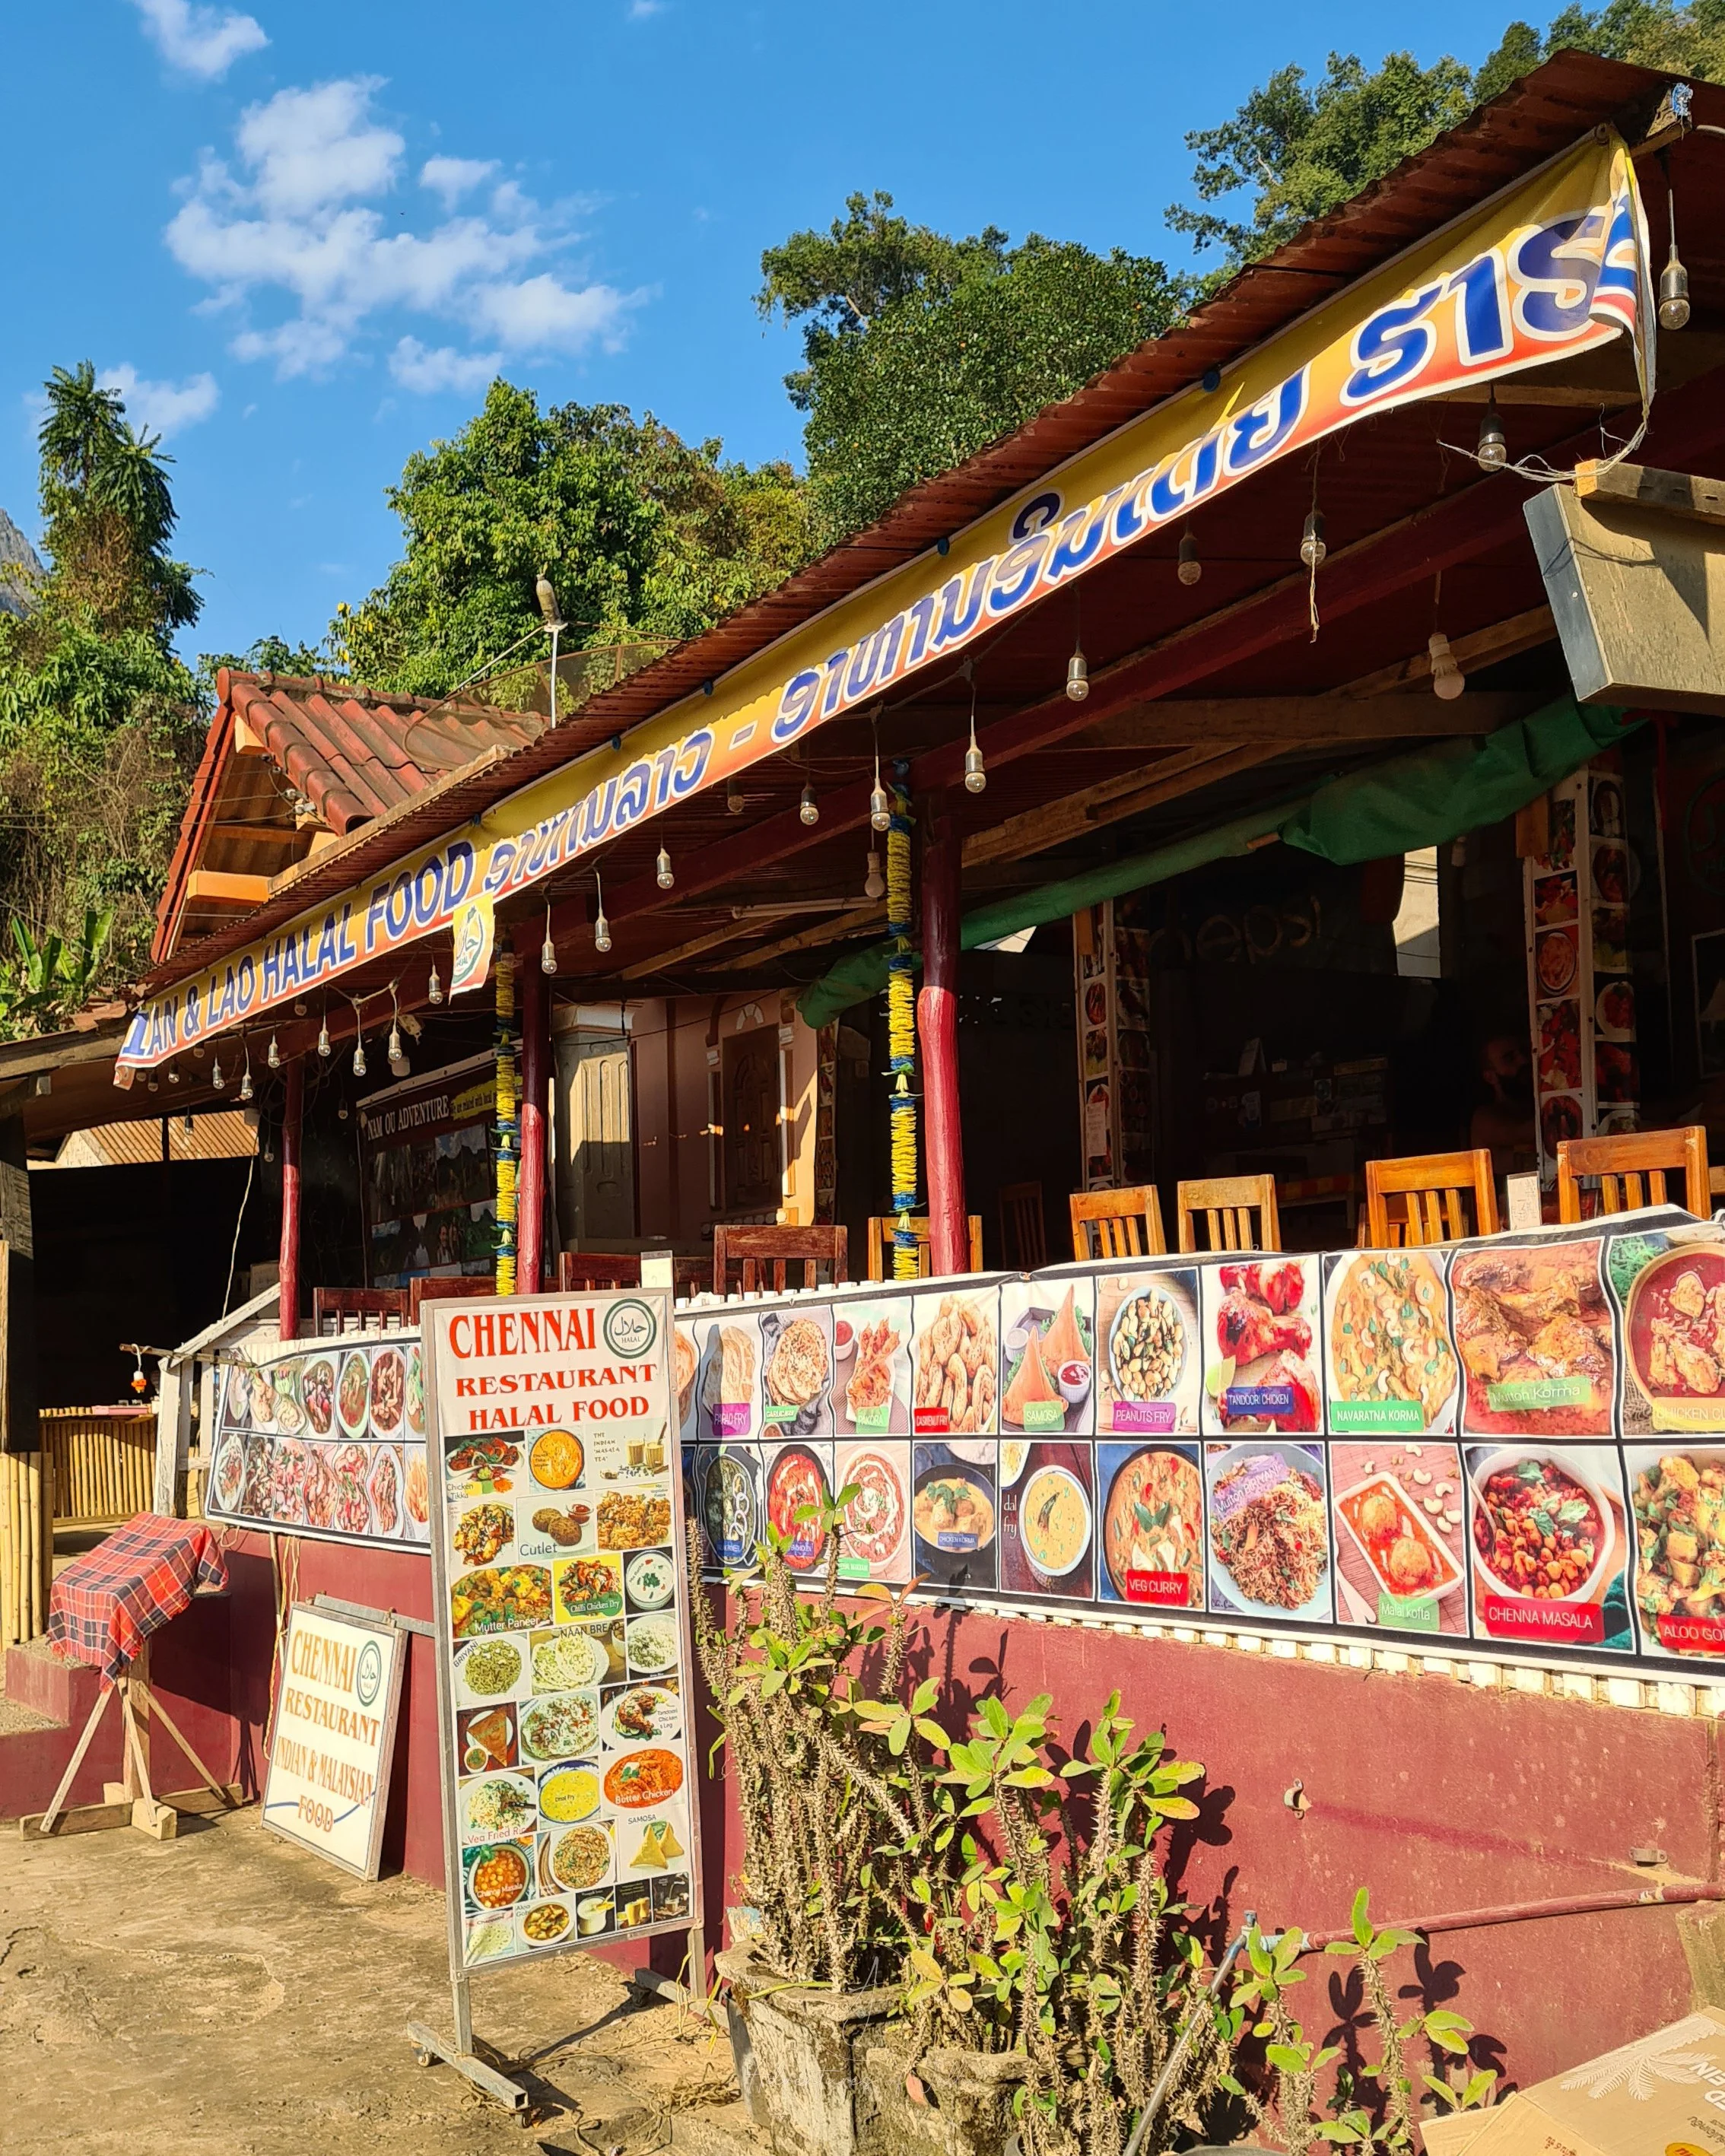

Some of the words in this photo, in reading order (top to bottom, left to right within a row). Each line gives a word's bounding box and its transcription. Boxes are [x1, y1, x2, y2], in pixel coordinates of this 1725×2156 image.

[185, 986, 200, 1038] &
[208, 955, 255, 1024] LAO
[262, 903, 355, 1000] HALAL
[367, 841, 474, 950] FOOD
[398, 1095, 450, 1131] ADVENTURE
[449, 1307, 597, 1359] CHENNAI
[456, 1364, 657, 1397] RESTAURANT
[1228, 1394, 1260, 1405] TANDOORI
[1262, 1394, 1289, 1405] CHICKEN
[1492, 1391, 1530, 1403] Mutton
[1533, 1385, 1580, 1399] Korma
[469, 1404, 563, 1431] HALAL
[572, 1396, 650, 1422] FOOD
[1026, 1409, 1058, 1421] SAMOSA
[1115, 1409, 1153, 1423] PEANUTS
[1155, 1411, 1171, 1424] FRY
[1336, 1410, 1387, 1421] NAVARATNA
[1389, 1410, 1419, 1421] KORMA
[1657, 1407, 1708, 1420] CHICKEN
[446, 1483, 474, 1491] Chicken
[1003, 1494, 1017, 1511] dal
[1215, 1489, 1244, 1513] Mutton
[1003, 1516, 1017, 1540] fry
[519, 1542, 558, 1557] Cutlet
[1129, 1578, 1148, 1592] VEG
[1148, 1580, 1183, 1595] CURRY
[587, 1601, 608, 1611] Chicken
[609, 1599, 620, 1609] Dry
[1407, 1607, 1430, 1620] kofta
[507, 1618, 540, 1628] Paneer
[1488, 1607, 1539, 1624] CHENNA
[1541, 1612, 1593, 1629] MASALA
[560, 1627, 586, 1639] NAAN
[590, 1622, 621, 1635] BREAD
[1664, 1624, 1699, 1640] ALOO
[291, 1629, 357, 1693] CHENNAI
[453, 1640, 478, 1668] BRIYANI
[286, 1688, 380, 1747] RESTAURANT
[275, 1735, 308, 1778] INDIAN
[308, 1750, 318, 1783] &
[318, 1753, 374, 1809] MALAYSIAN
[615, 1795, 641, 1805] Butter
[642, 1789, 674, 1800] Chicken
[298, 1795, 335, 1833] FOOD
[627, 1814, 656, 1824] SAMOSA
[488, 1828, 510, 1840] Fried
